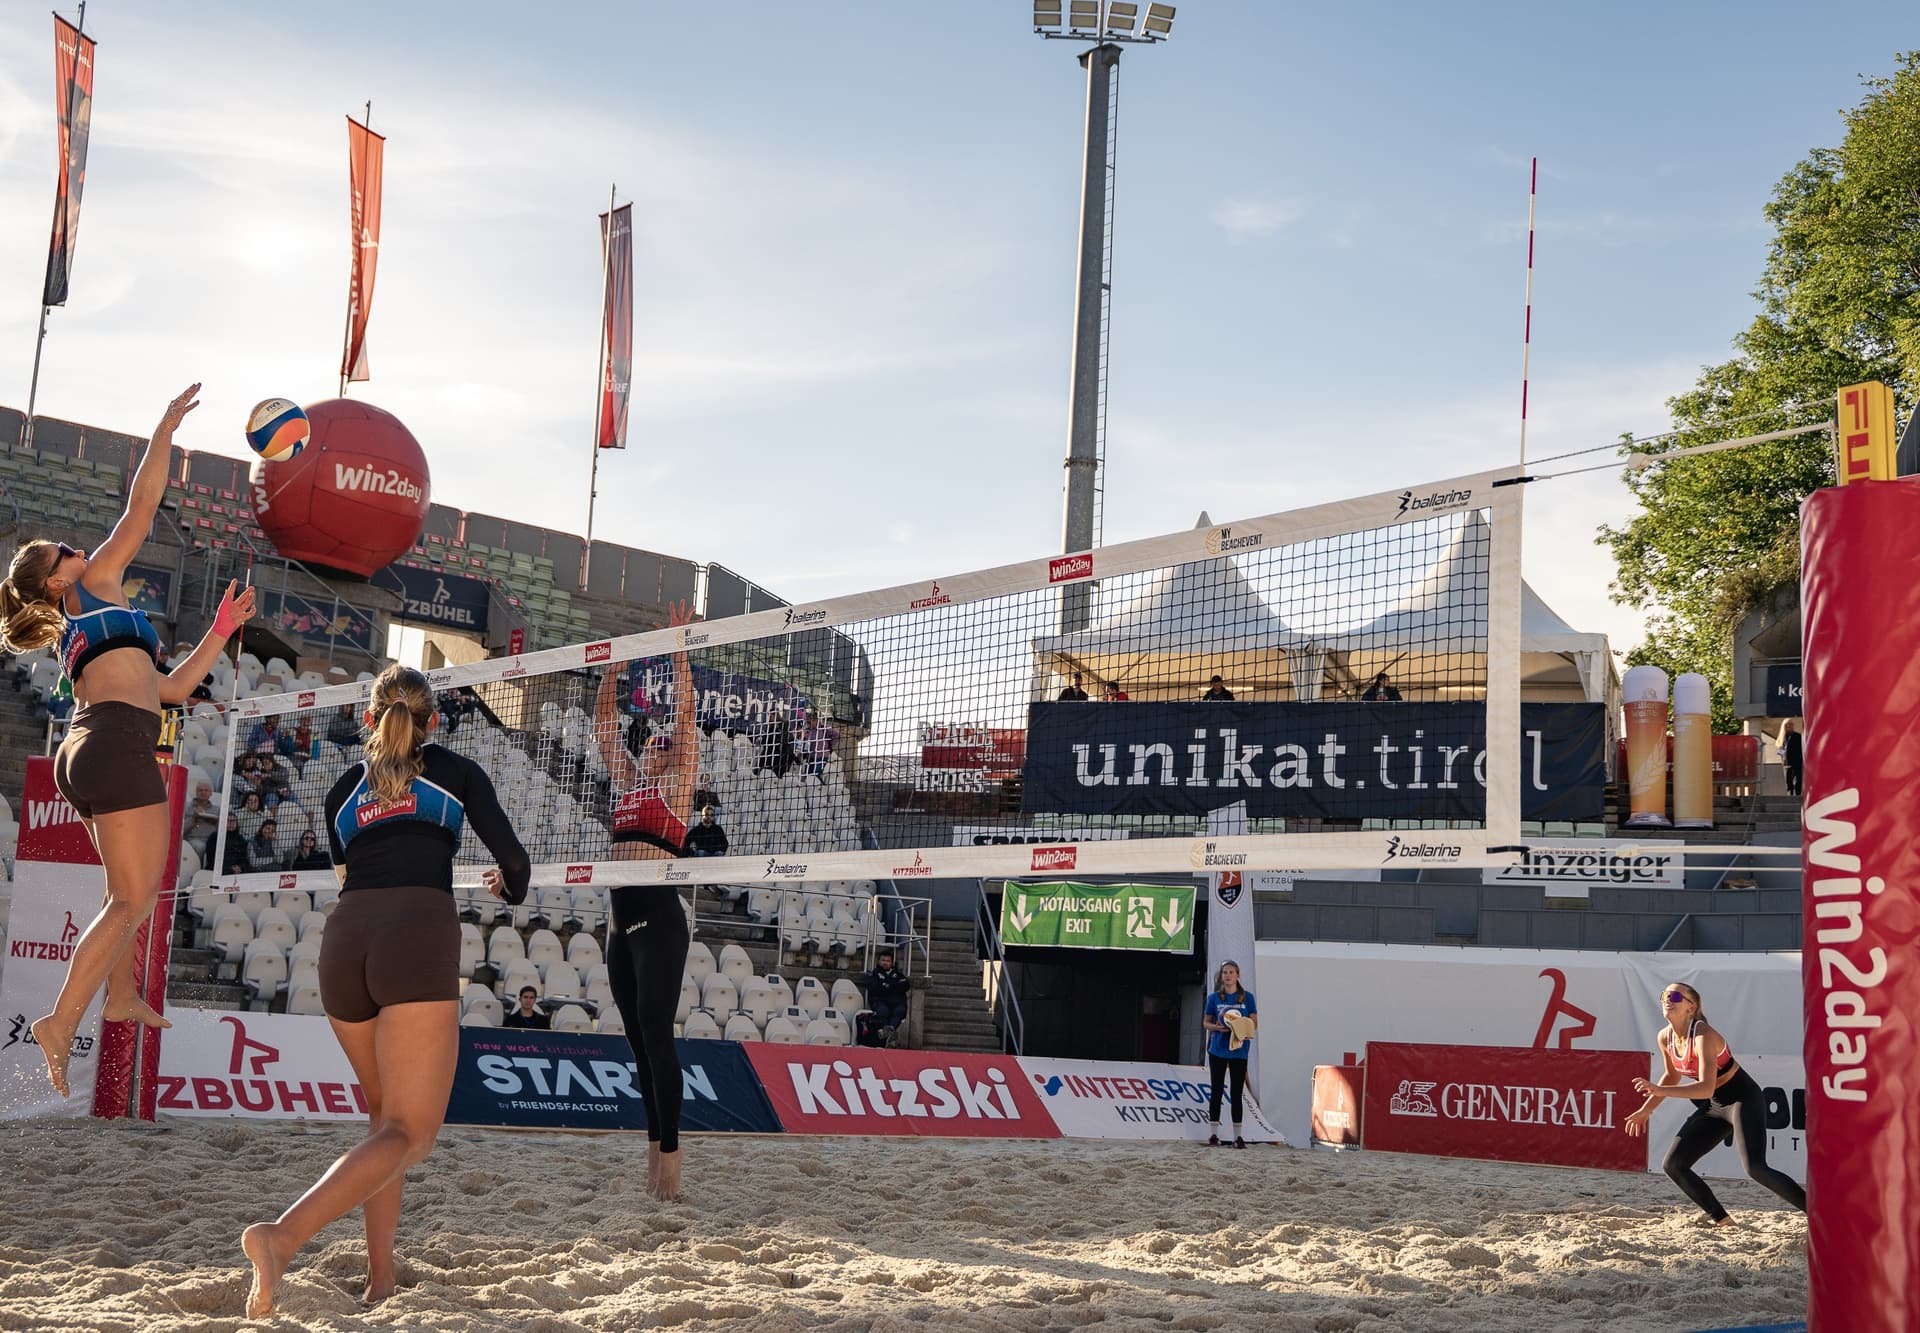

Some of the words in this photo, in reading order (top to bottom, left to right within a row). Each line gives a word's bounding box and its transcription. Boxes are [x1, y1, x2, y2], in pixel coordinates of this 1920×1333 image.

[1411, 489, 1472, 510] ballarina
[1221, 533, 1262, 551] BEACHEVENT
[1072, 728, 1548, 791] unikat.tirl
[1400, 843, 1462, 857] ballarina
[774, 863, 807, 874] ballarina
[1205, 854, 1247, 866] BEACHEVENT
[1039, 896, 1121, 914] NOTAUSGANG
[1066, 918, 1092, 934] EXIT
[786, 1060, 1021, 1120] KitzSki
[512, 1100, 619, 1113] FRIENDSFACTORY
[1441, 1083, 1617, 1129] GENERALI
